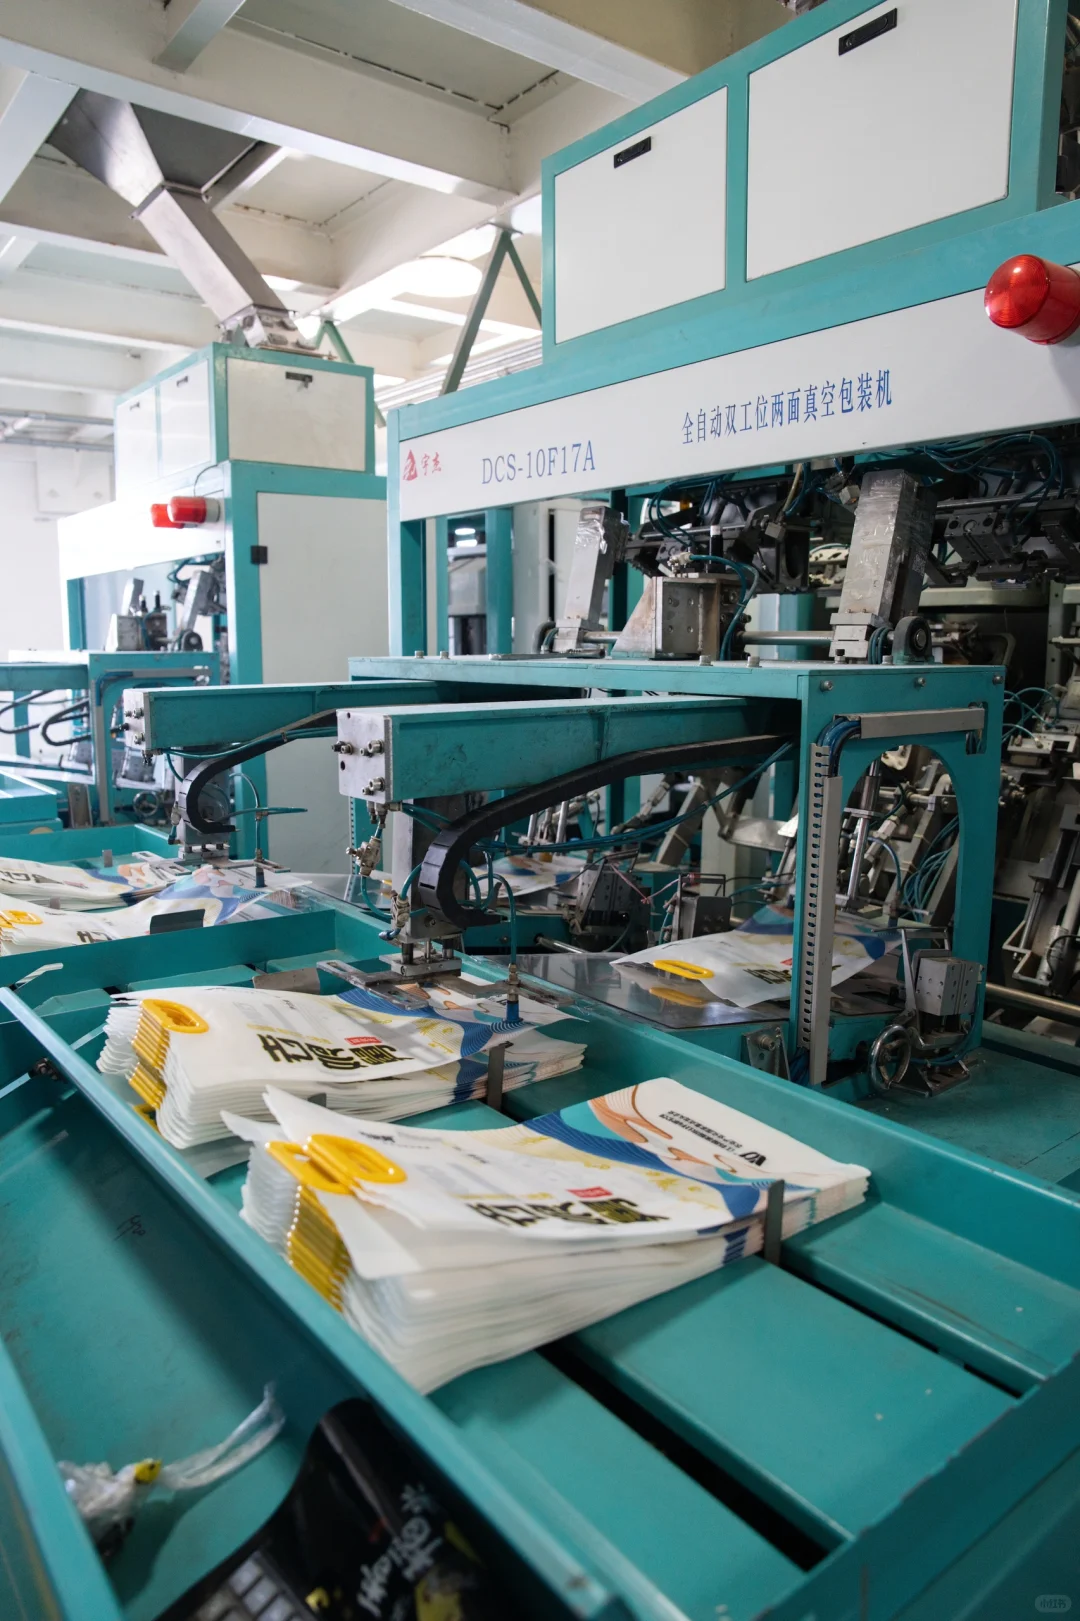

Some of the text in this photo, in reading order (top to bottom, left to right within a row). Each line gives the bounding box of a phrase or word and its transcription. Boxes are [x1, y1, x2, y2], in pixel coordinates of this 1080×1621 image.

[682, 369, 892, 445] 全自动双工位两面真空包装机
[481, 440, 596, 485] DCS-10F17A
